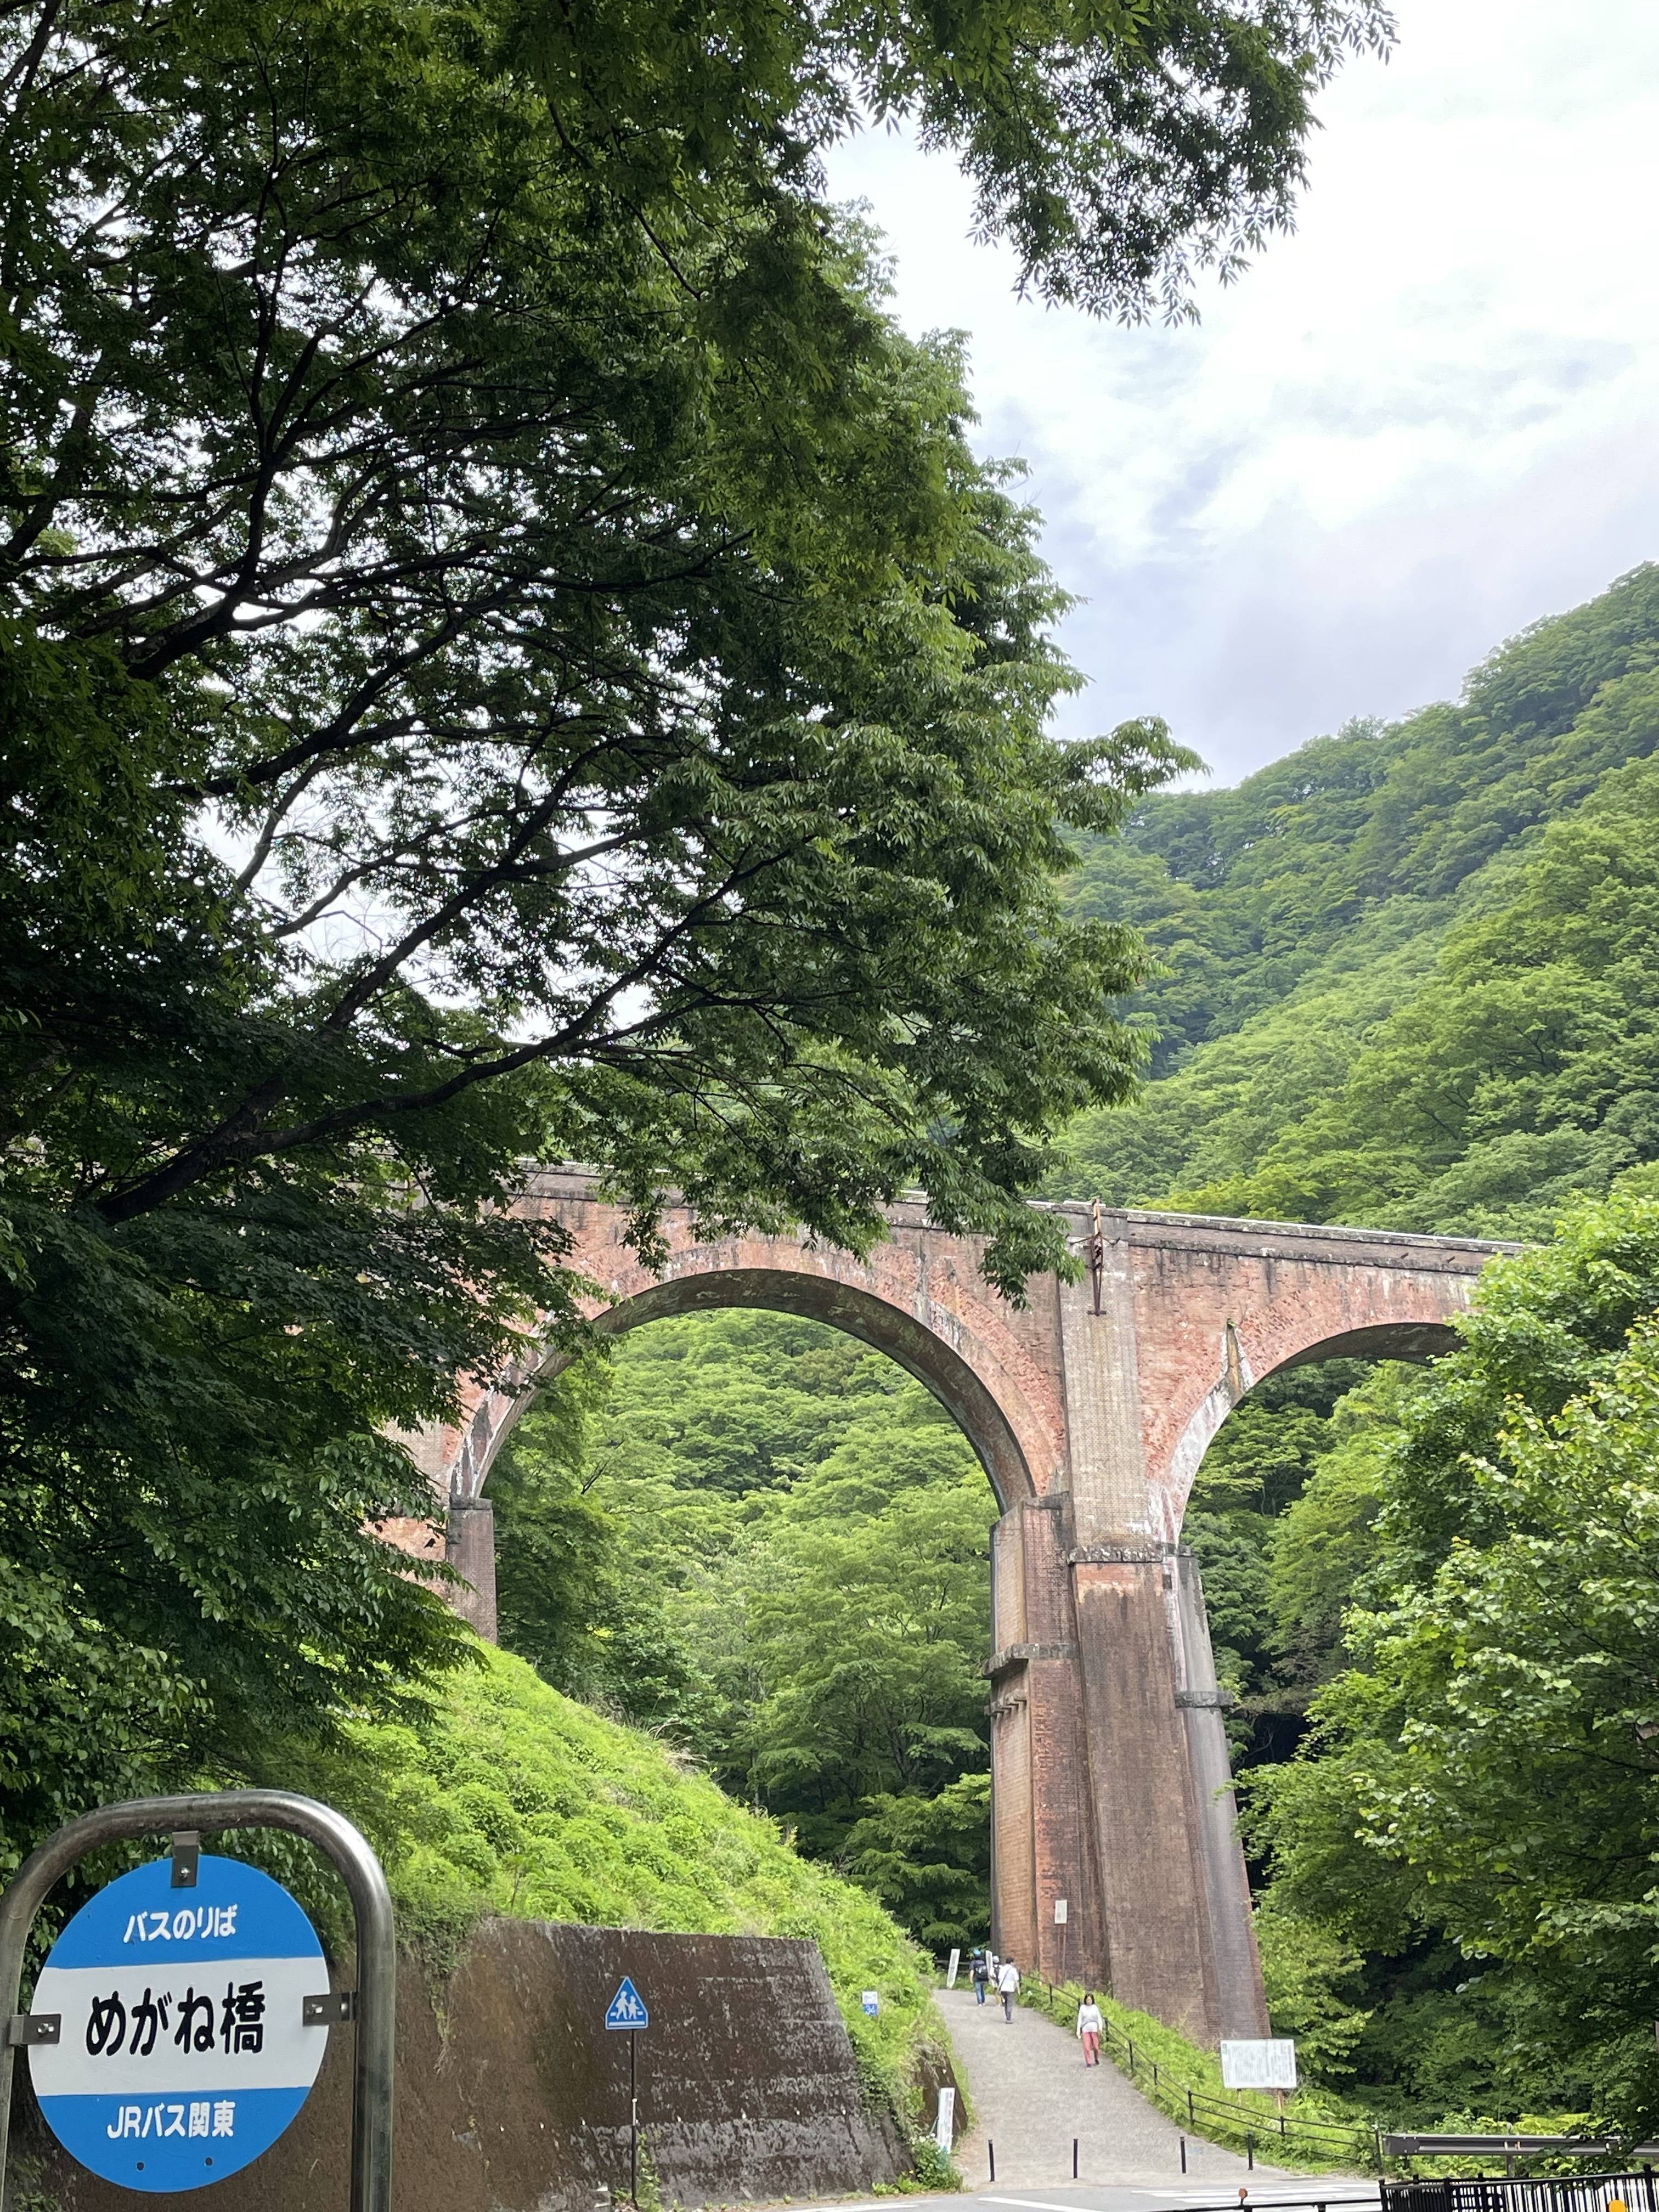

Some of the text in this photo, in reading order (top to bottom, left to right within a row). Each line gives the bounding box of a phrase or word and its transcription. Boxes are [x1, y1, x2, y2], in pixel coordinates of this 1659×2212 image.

[122, 1904, 238, 1943] バスのりば
[86, 1980, 266, 2057] めがね橋
[106, 2100, 236, 2139] JRバス関東
